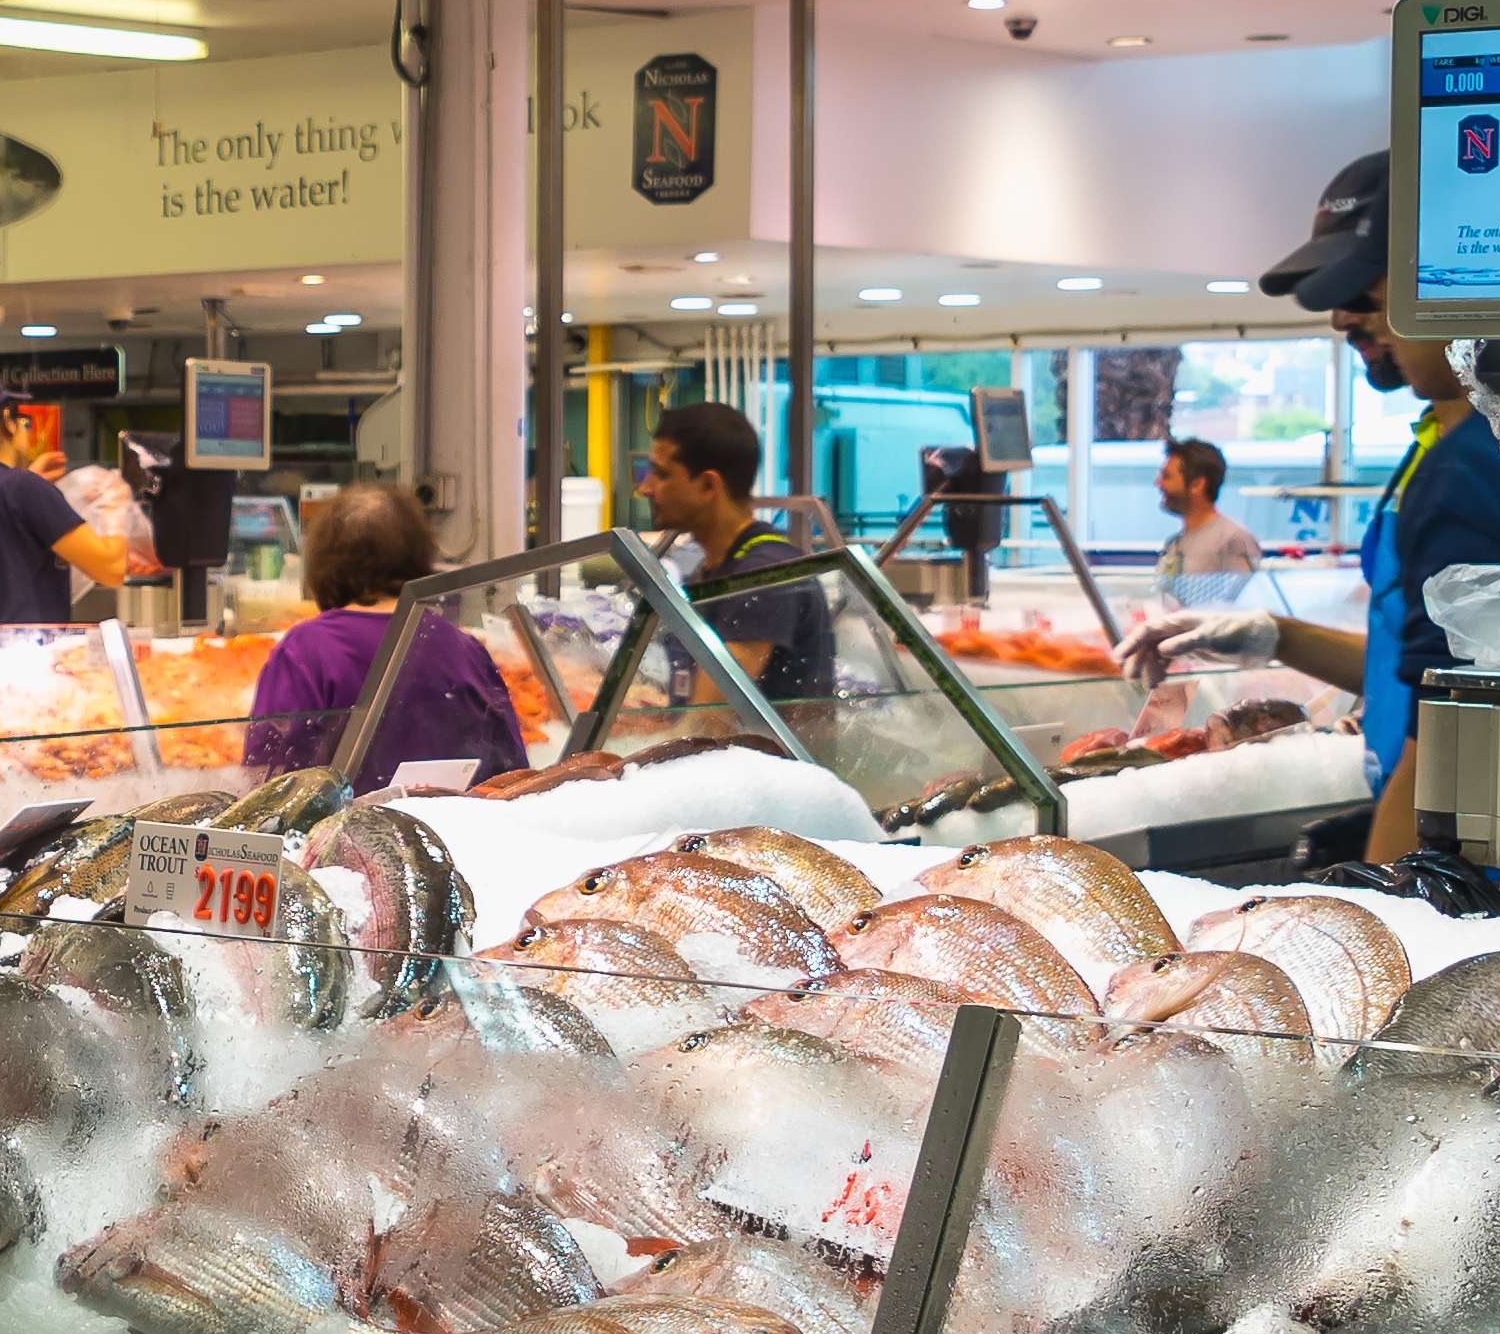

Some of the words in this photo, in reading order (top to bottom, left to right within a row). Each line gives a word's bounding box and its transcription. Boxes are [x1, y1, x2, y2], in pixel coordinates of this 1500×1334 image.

[1445, 72, 1484, 93] 0.000
[646, 97, 704, 163] N
[154, 128, 209, 167] The
[216, 122, 283, 170] only
[294, 117, 377, 162] thing
[161, 186, 184, 218] is
[194, 178, 243, 216] the
[250, 169, 350, 210] water!
[1457, 224, 1482, 239] The
[1457, 242, 1468, 254] is
[1470, 241, 1491, 254] the
[82, 363, 115, 381] Here
[139, 835, 189, 856] OCEAN
[138, 854, 187, 875] TROUT
